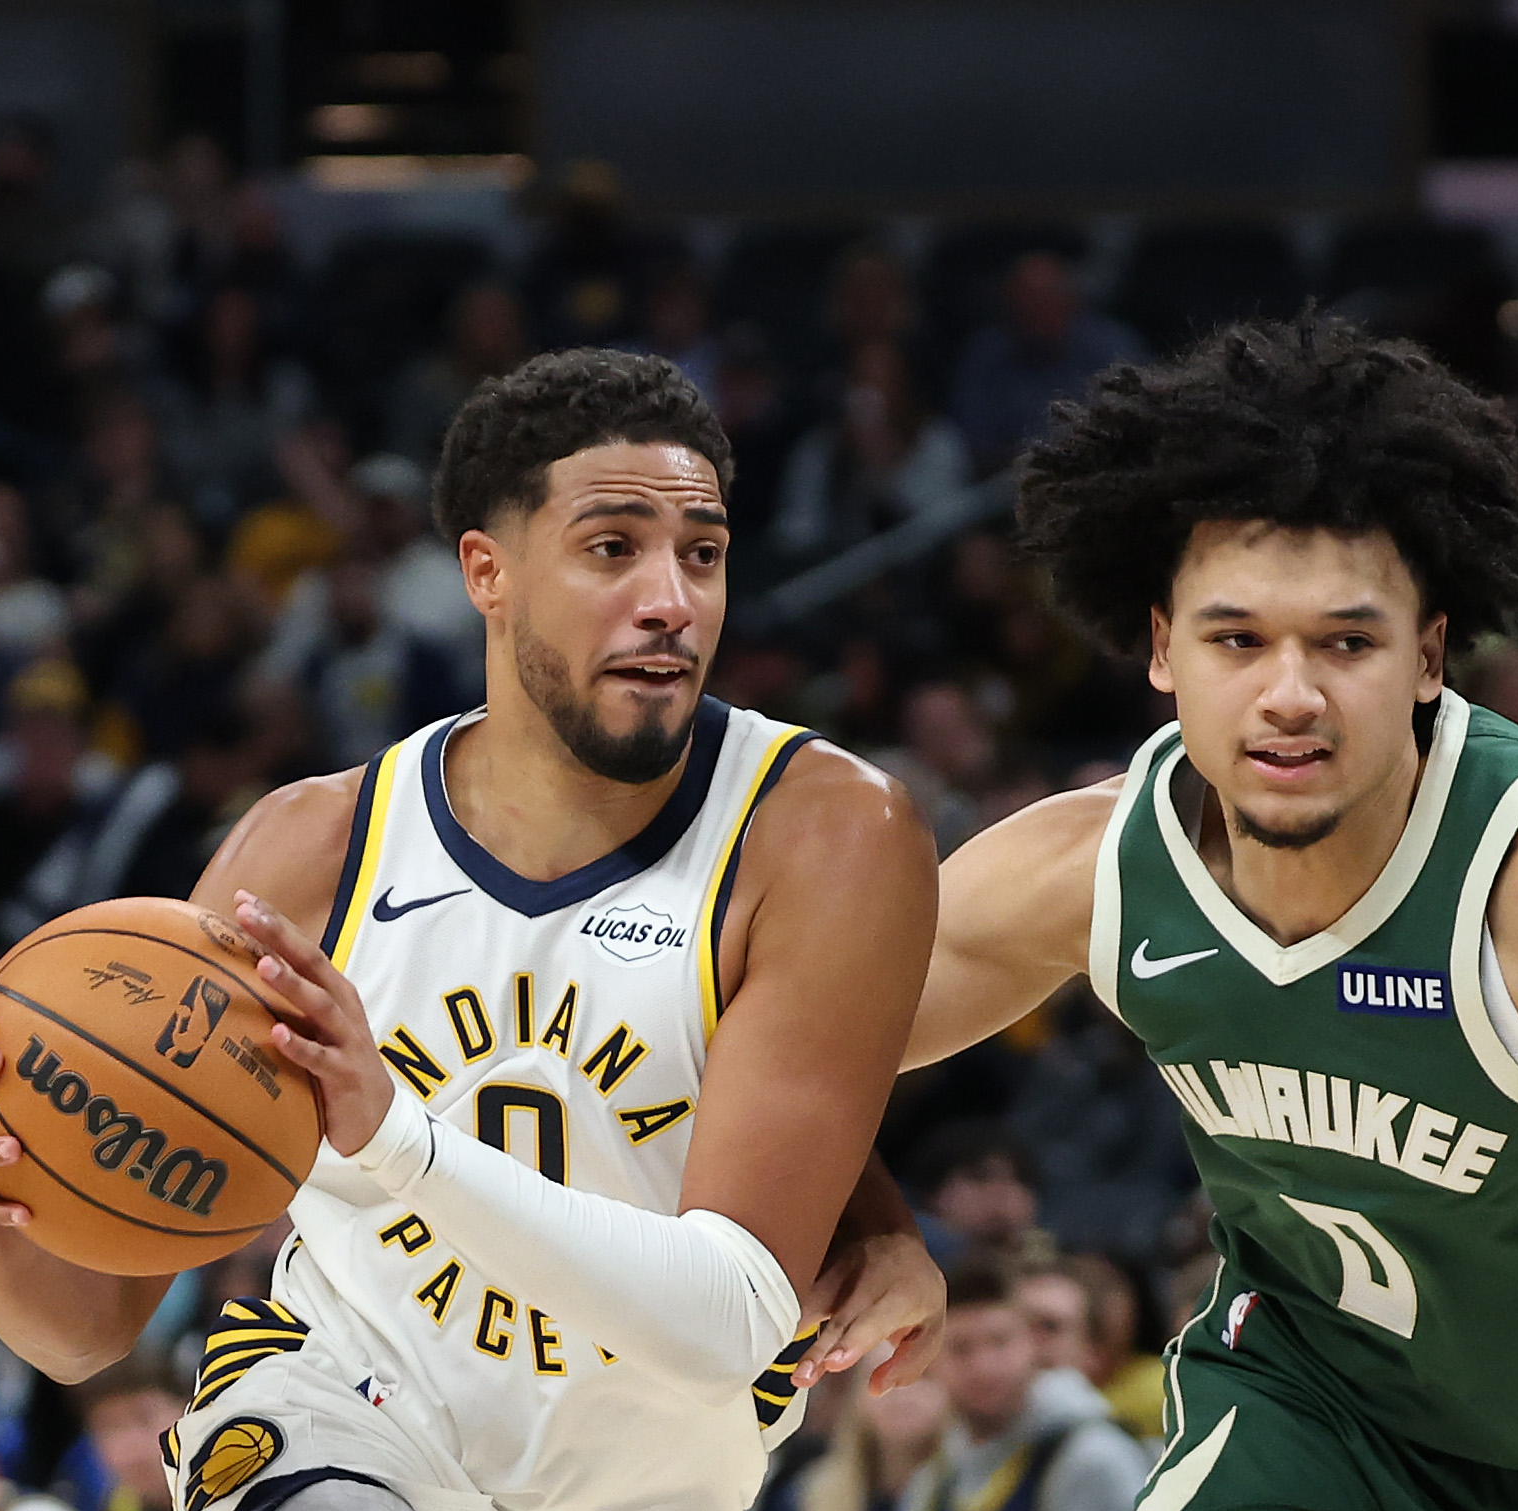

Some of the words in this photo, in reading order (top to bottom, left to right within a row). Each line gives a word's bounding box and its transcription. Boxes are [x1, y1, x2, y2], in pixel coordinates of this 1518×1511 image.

[579, 915, 653, 943] LUCAS
[654, 927, 687, 948] OIL
[1342, 971, 1445, 1009] ULINE
[16, 1033, 229, 1218] Wilson
[378, 971, 696, 1147] NDIANA
[1157, 1059, 1508, 1194] ILWAUKEE
[473, 1079, 570, 1187] 0
[376, 1209, 620, 1377] PACE
